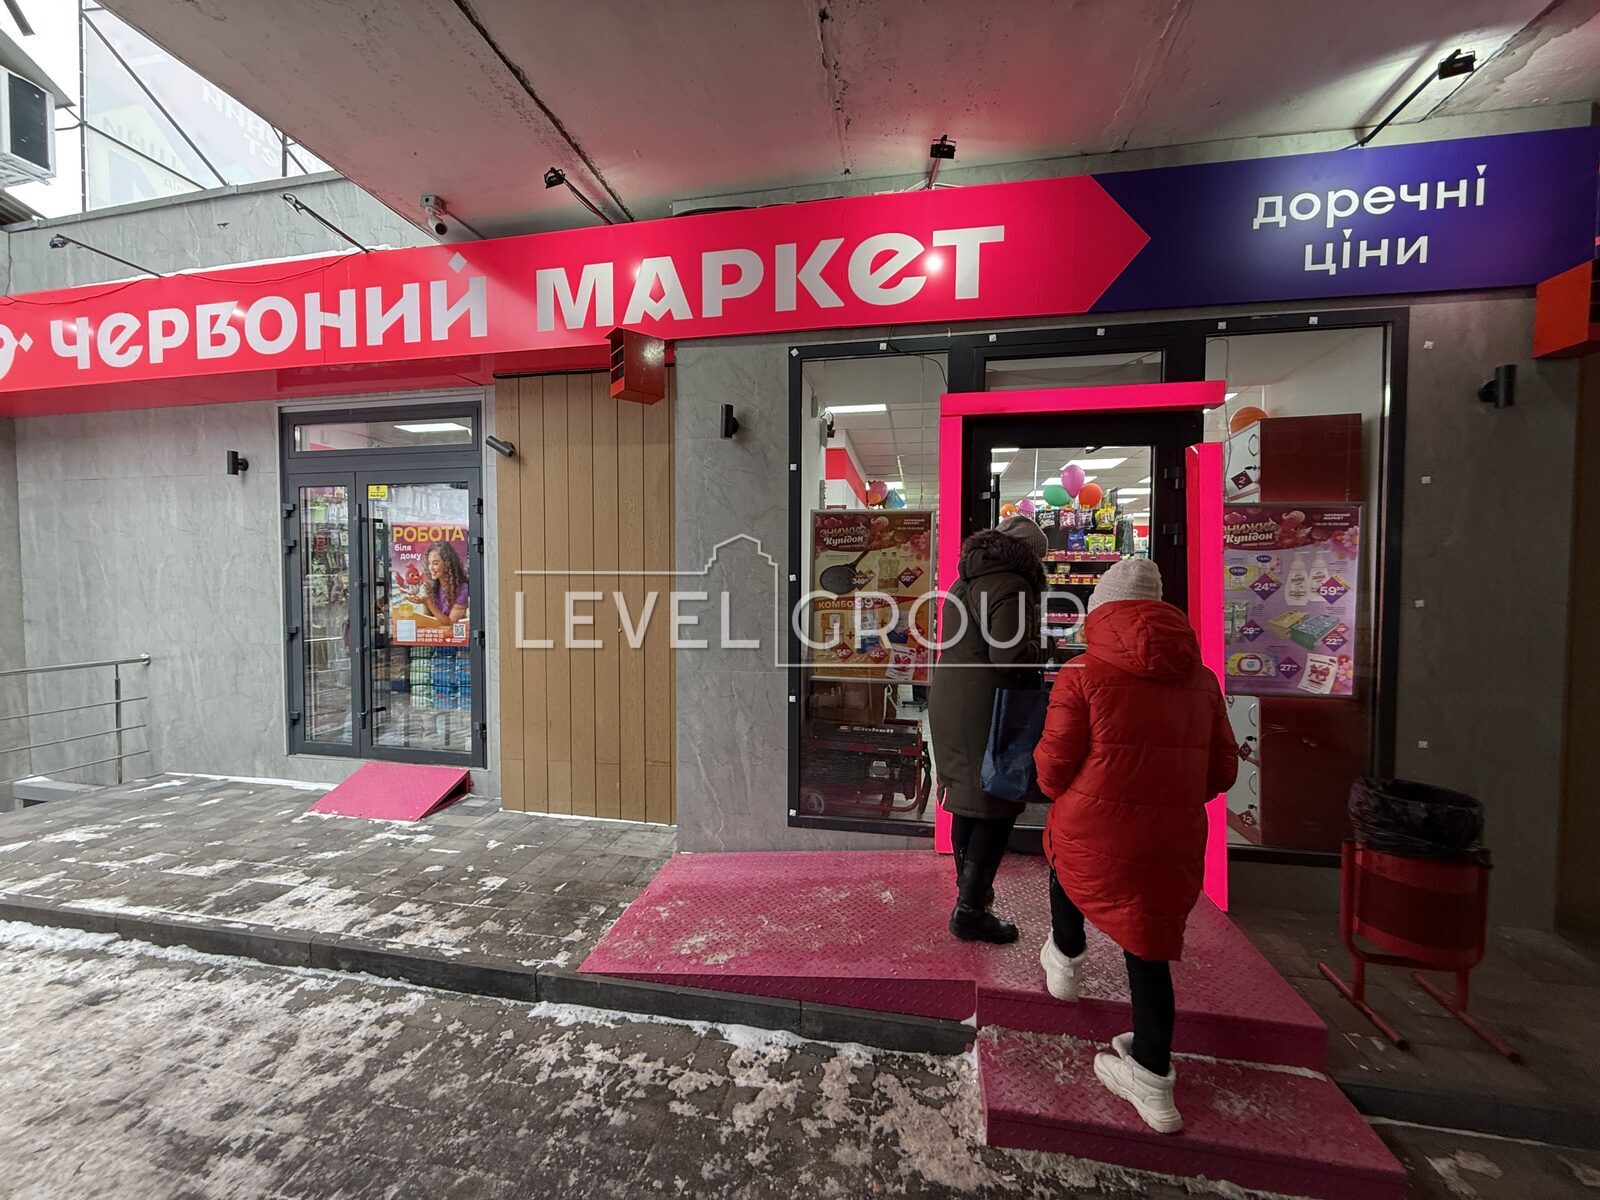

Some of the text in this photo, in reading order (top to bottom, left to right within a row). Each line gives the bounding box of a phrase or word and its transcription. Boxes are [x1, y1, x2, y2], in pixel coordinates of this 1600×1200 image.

[1252, 164, 1487, 230] доречні
[1304, 228, 1429, 276] ціни
[392, 524, 466, 543] РОБОТА
[1223, 531, 1273, 545] Купідон
[823, 534, 864, 547] Купідон
[394, 543, 412, 552] біля
[399, 552, 422, 562] дому
[818, 599, 854, 609] КОМБО
